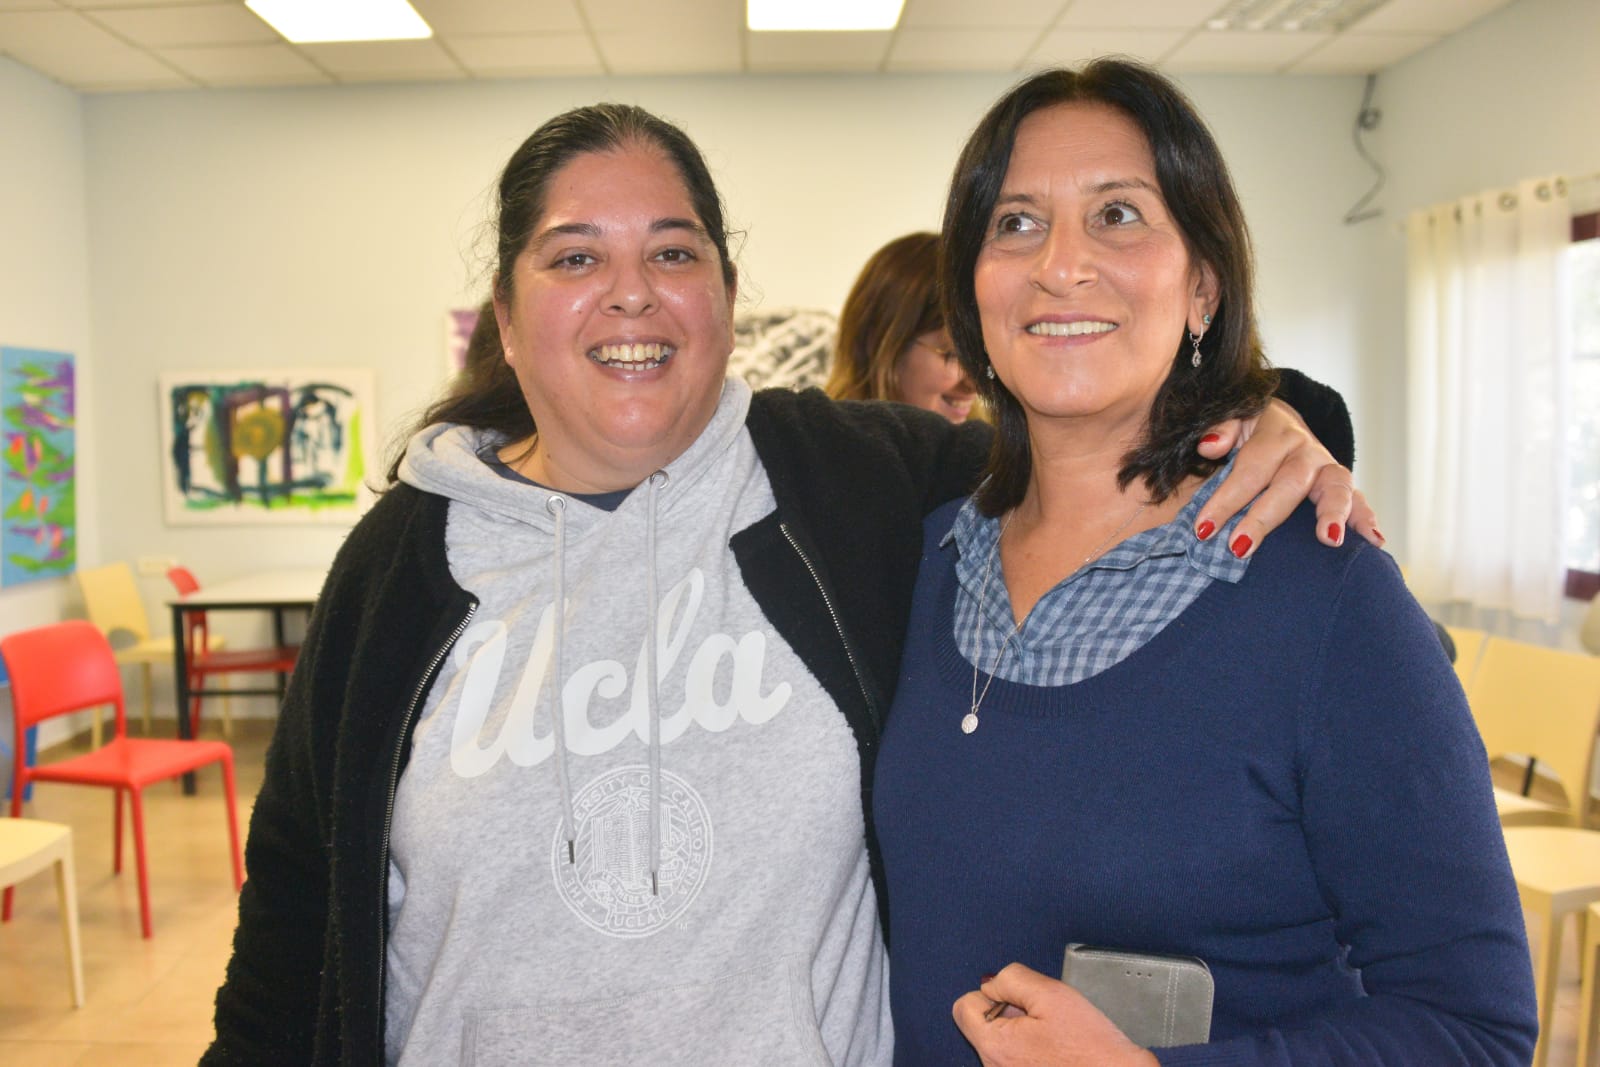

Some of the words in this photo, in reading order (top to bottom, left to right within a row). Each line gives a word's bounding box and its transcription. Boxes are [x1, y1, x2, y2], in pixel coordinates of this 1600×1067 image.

[560, 774, 627, 866] UNERSITY
[671, 789, 703, 896] CALIFORNIA
[564, 877, 587, 908] THE
[614, 912, 657, 928] UCLA
